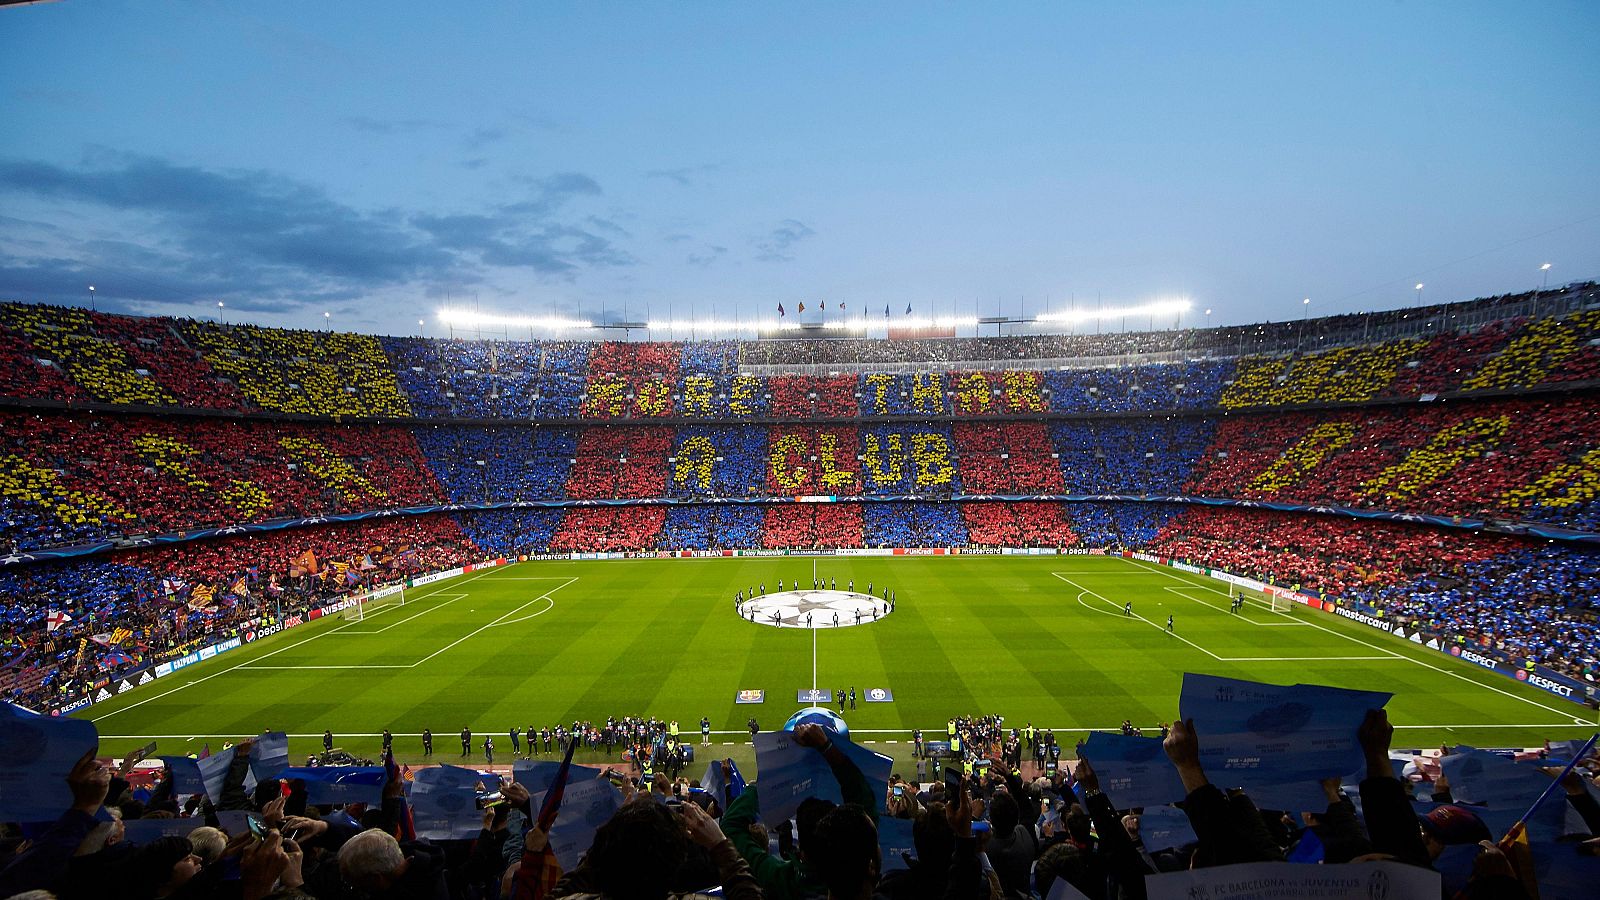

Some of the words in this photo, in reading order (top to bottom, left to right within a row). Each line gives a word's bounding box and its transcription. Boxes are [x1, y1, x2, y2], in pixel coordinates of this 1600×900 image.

[674, 435, 717, 489] A
[770, 433, 955, 489] CLUB
[1132, 552, 1160, 564] NISSAN
[1173, 561, 1200, 575] Heineken
[1217, 573, 1236, 582] SONY
[1281, 589, 1308, 605] UniCredit
[321, 597, 357, 616] NISSAN
[1336, 606, 1390, 631] mastercard
[257, 621, 283, 640] pepsi
[217, 636, 241, 653] GAZPROM
[173, 651, 200, 670] GAZPROM
[1461, 650, 1498, 669] RESPECT
[1529, 673, 1573, 697] RESPECT
[61, 697, 90, 714] RESPECT
[95, 692, 113, 703] adidas
[1214, 884, 1226, 895] FC
[1228, 879, 1285, 894] BARCELONA
[1302, 879, 1360, 888] JUVENTUS
